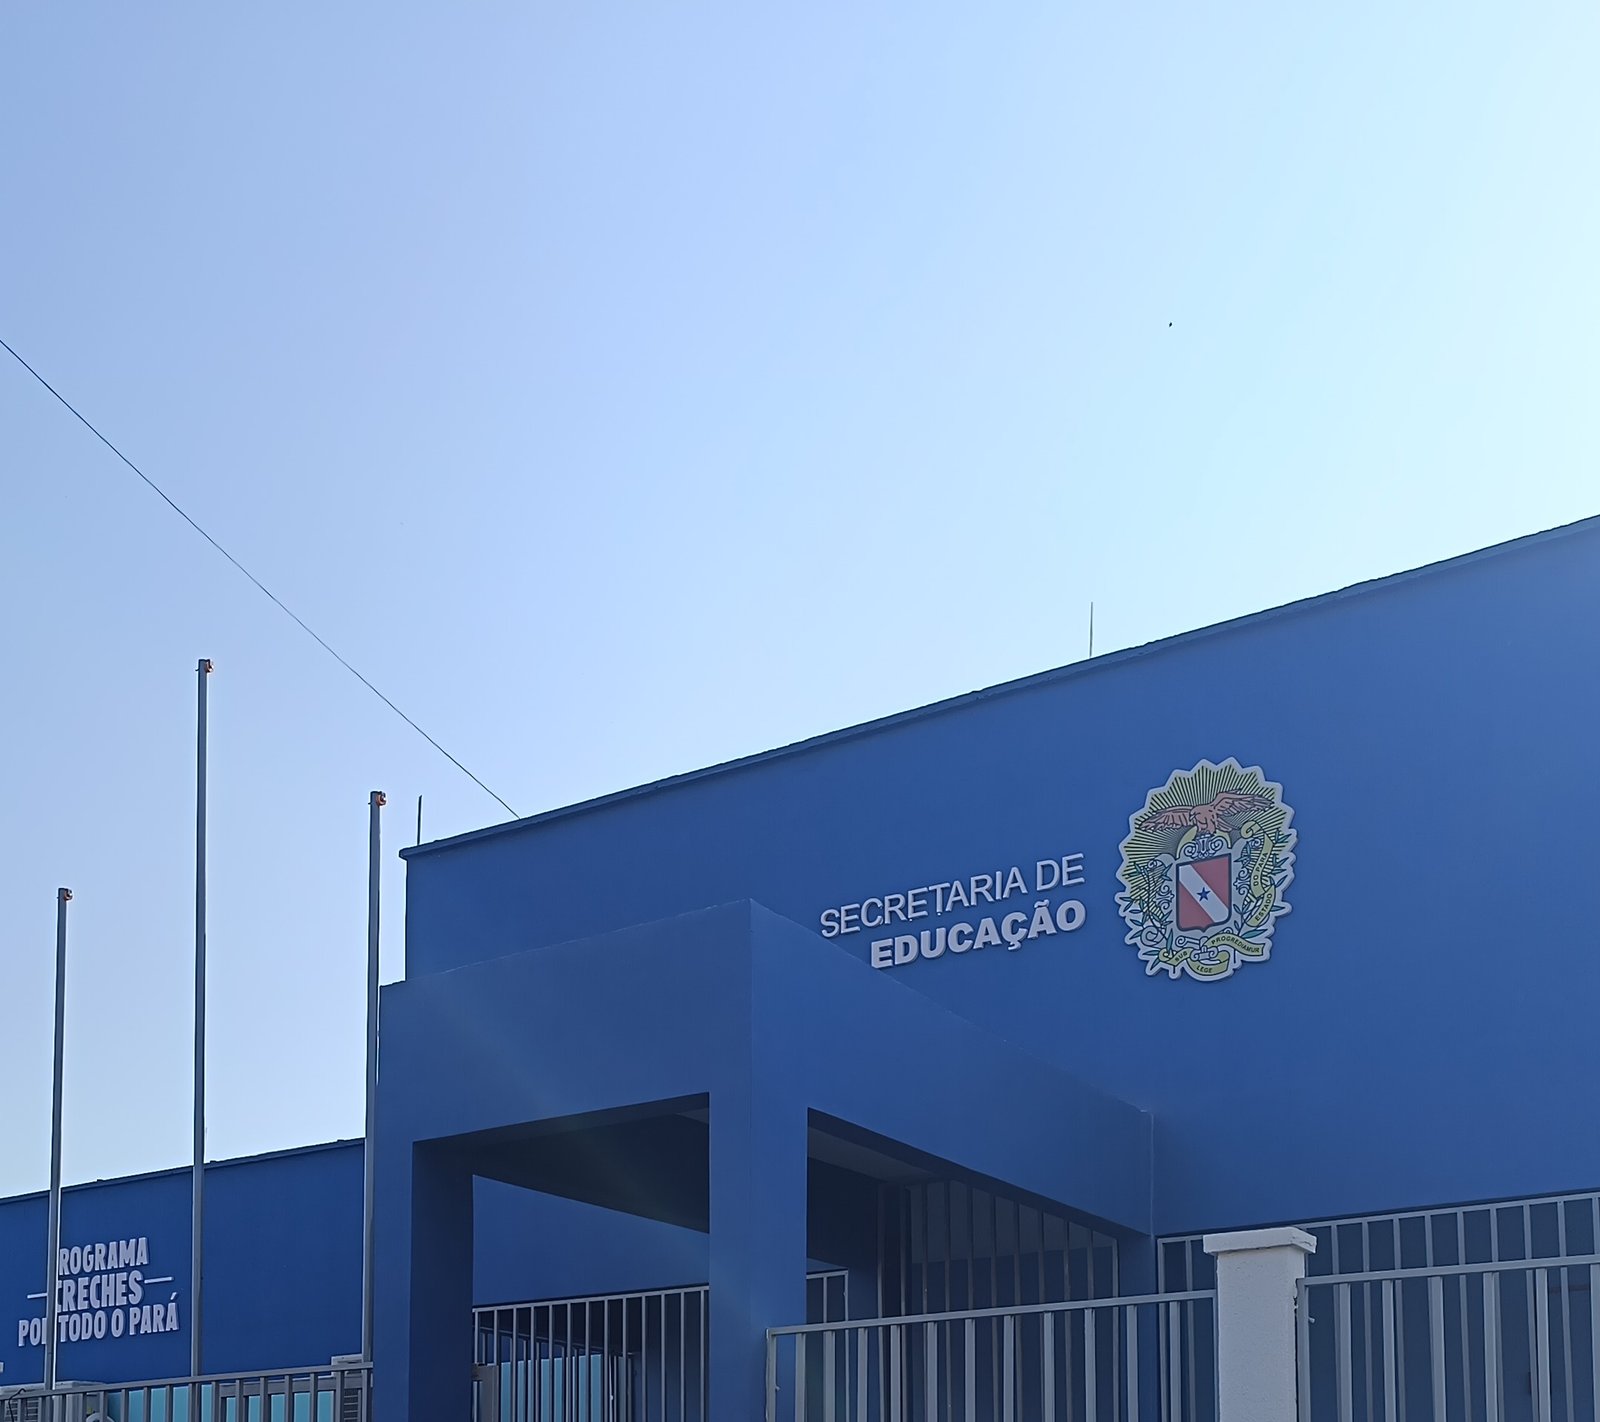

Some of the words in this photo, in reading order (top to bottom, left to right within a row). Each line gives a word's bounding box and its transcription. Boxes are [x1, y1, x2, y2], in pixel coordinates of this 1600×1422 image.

[820, 866, 1028, 938] SECRETARIA
[1036, 853, 1085, 892] DE
[1253, 874, 1259, 887] DO
[1254, 893, 1273, 922] ESTADO
[871, 899, 1086, 969] EDUCAÇÃO
[1174, 951, 1188, 962] SUB
[1210, 935, 1261, 953] PROGREDIAMUR
[59, 1237, 149, 1275] ROGRAMA
[58, 1310, 106, 1342] TODO
[111, 1309, 124, 1337] O
[129, 1292, 180, 1336] PARÁ
